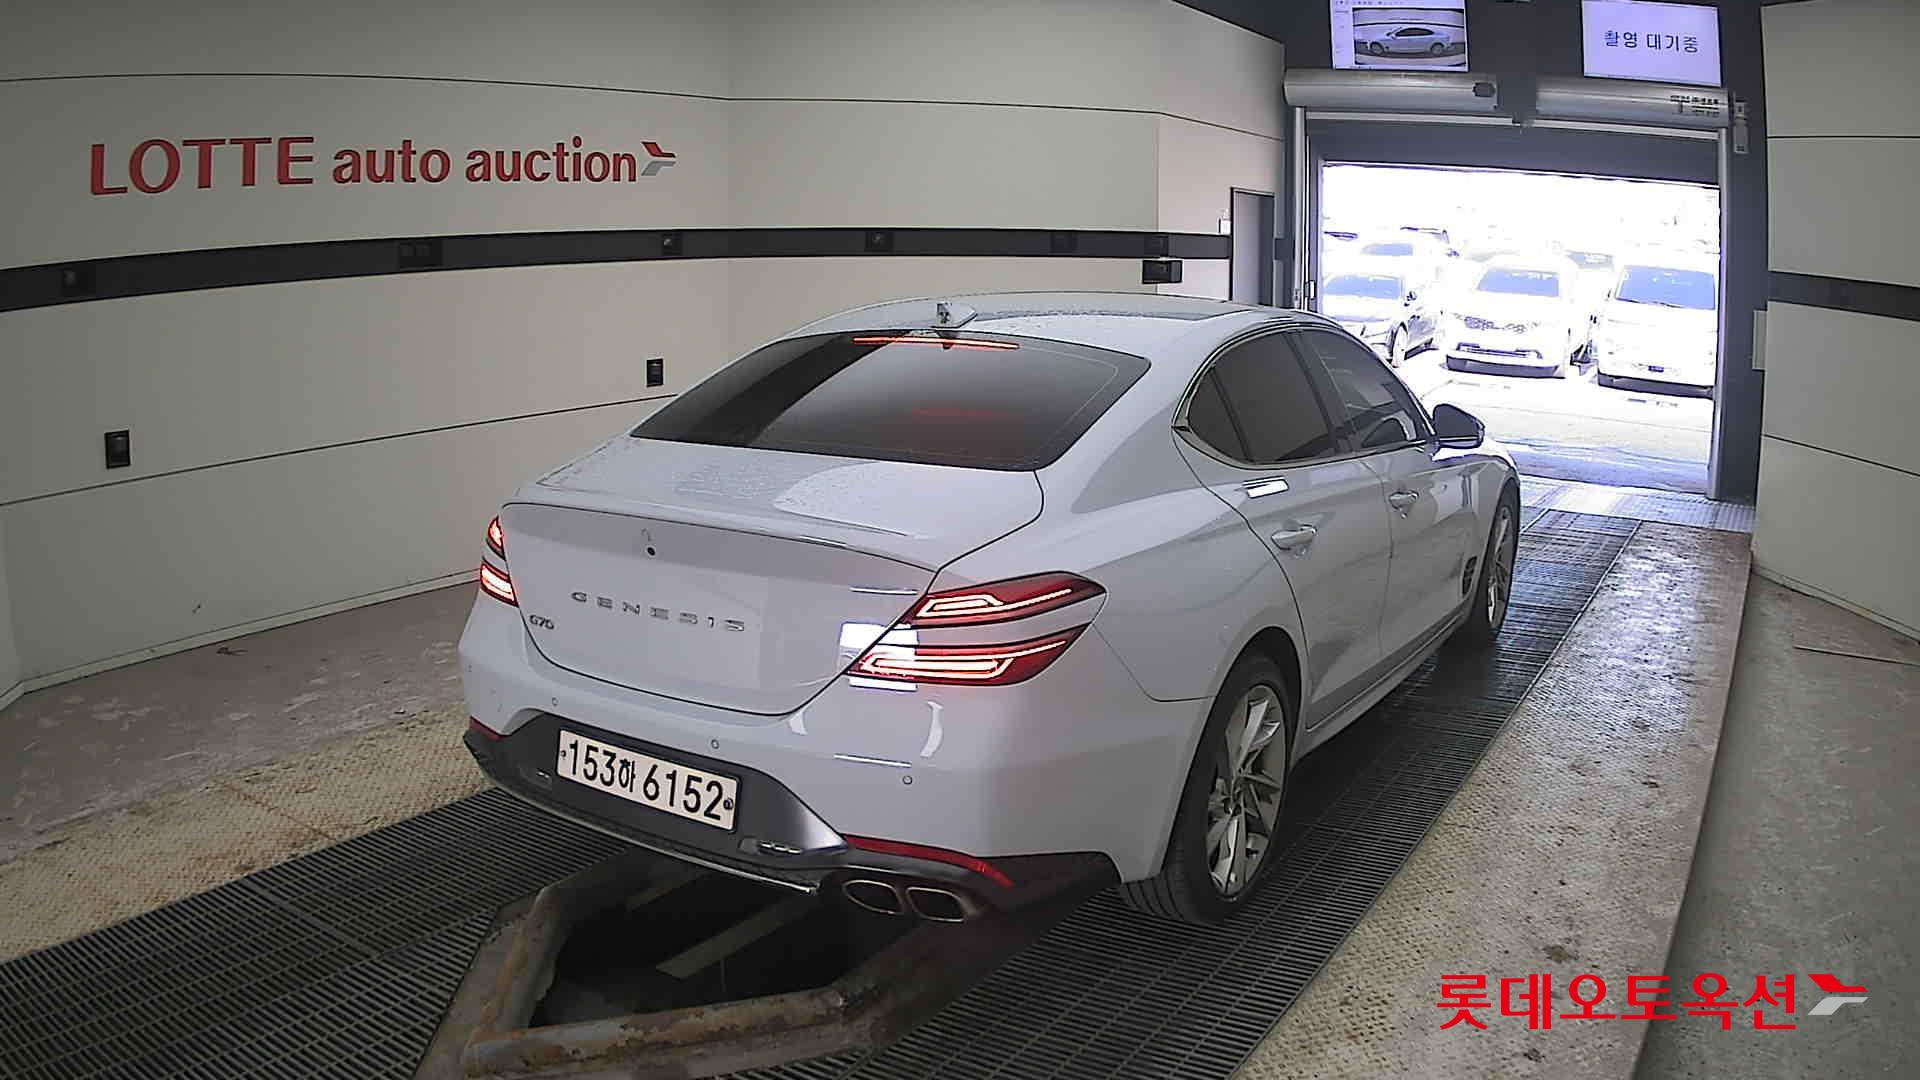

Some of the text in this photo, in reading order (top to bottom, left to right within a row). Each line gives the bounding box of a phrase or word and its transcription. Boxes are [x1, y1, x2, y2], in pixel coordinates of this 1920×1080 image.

[1604, 30, 1698, 53] 촬영 대기중
[90, 136, 638, 196] LOTTE auto auction
[529, 614, 555, 630] G70
[571, 591, 745, 632] GENESIS
[643, 764, 723, 820] 6152
